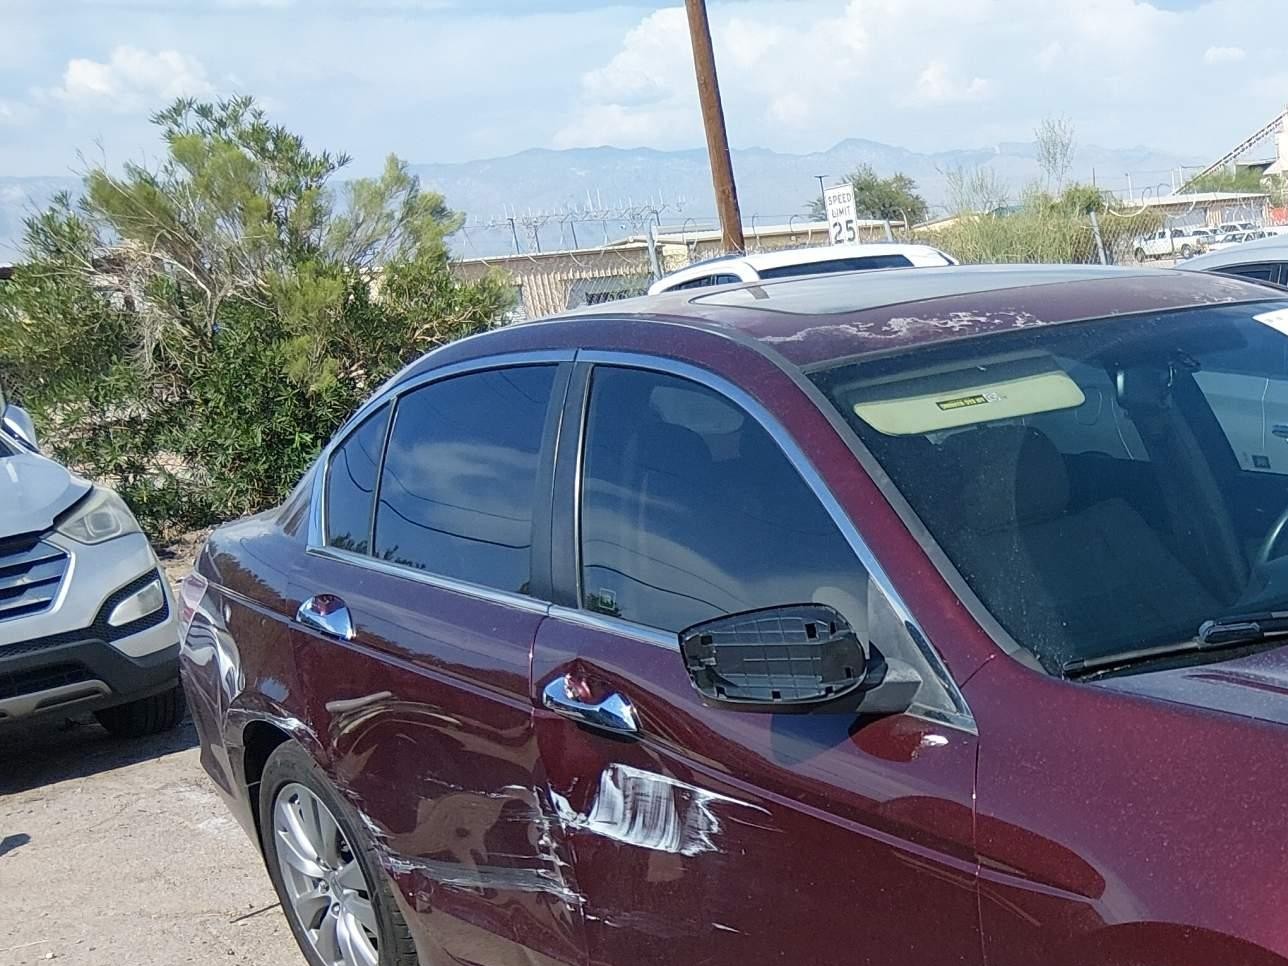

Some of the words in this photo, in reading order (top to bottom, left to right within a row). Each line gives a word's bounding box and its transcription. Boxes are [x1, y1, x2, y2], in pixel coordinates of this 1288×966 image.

[828, 192, 852, 206] SPEED
[831, 205, 851, 218] LIMIT
[832, 219, 856, 245] 25
